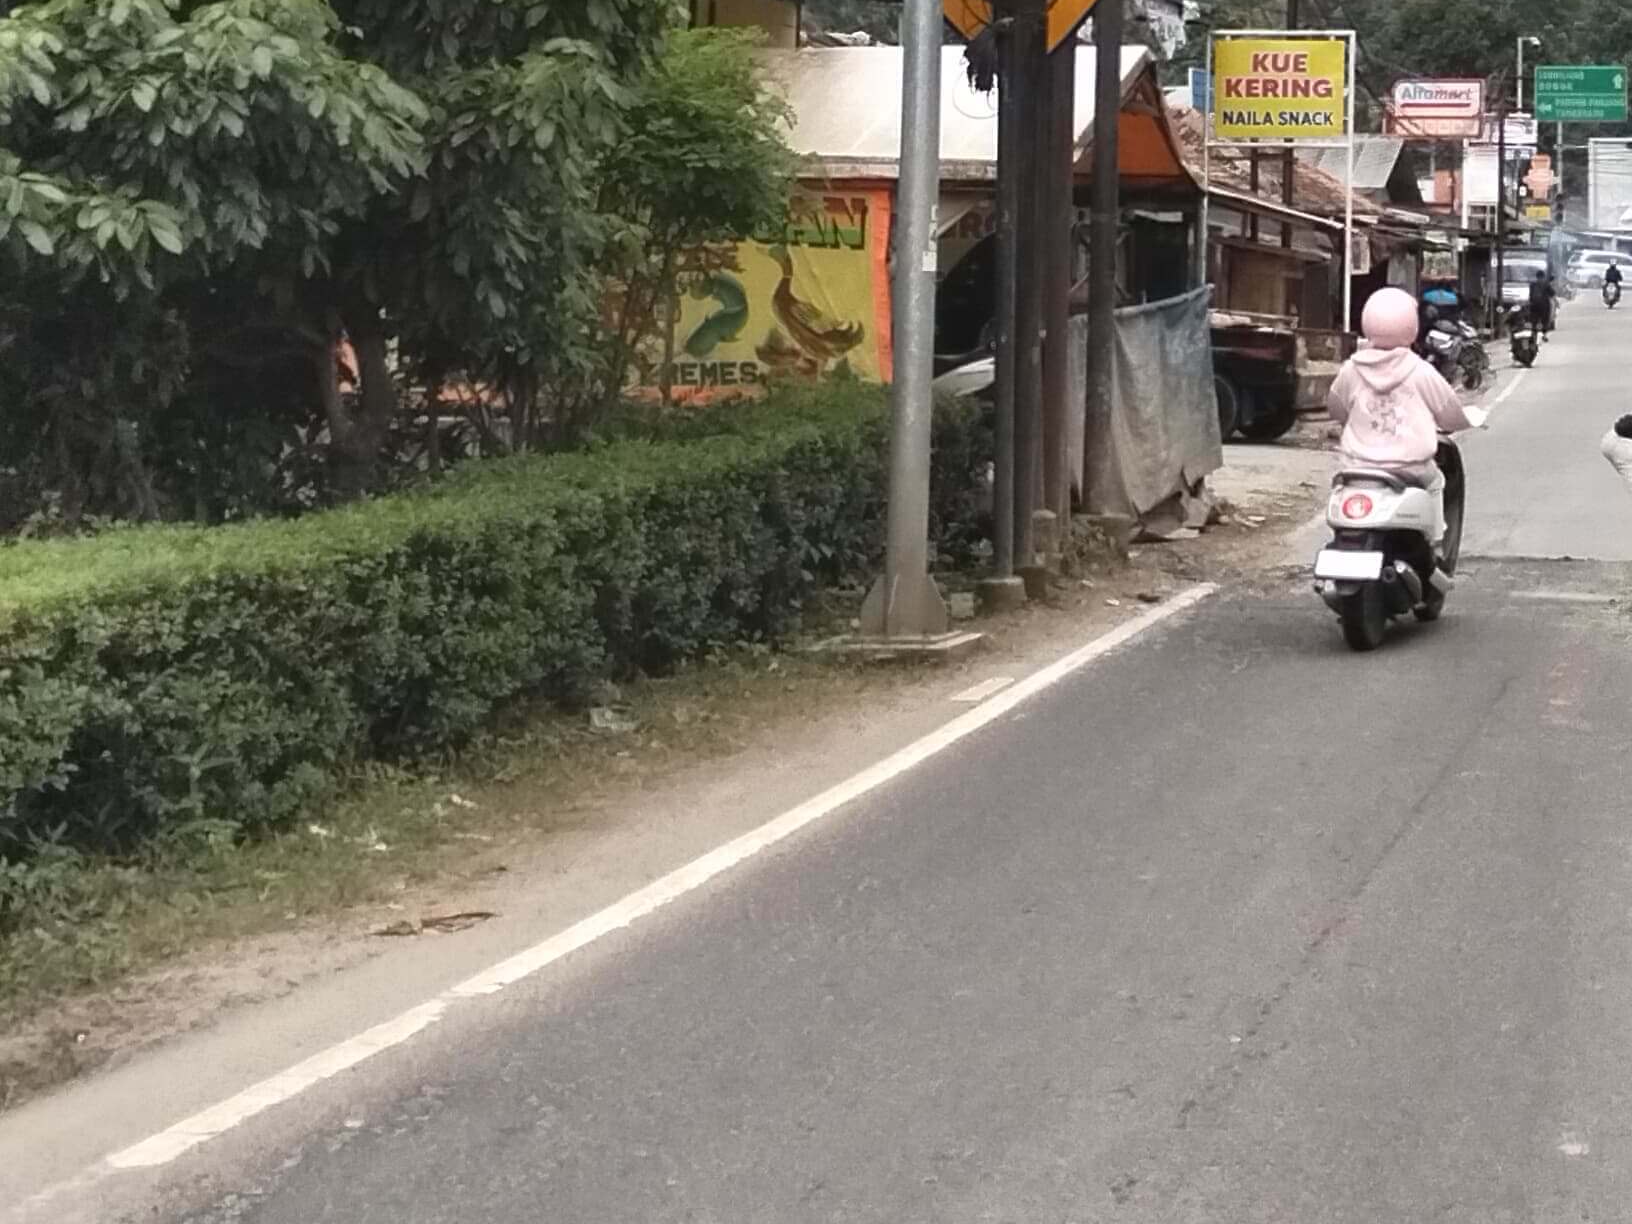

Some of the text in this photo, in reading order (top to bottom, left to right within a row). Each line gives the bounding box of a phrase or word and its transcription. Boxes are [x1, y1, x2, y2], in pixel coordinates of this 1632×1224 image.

[1252, 53, 1308, 73] KUE
[1225, 78, 1333, 98] KERING
[1401, 86, 1472, 100] Alfamart
[1223, 111, 1333, 126] NAILA SNACK
